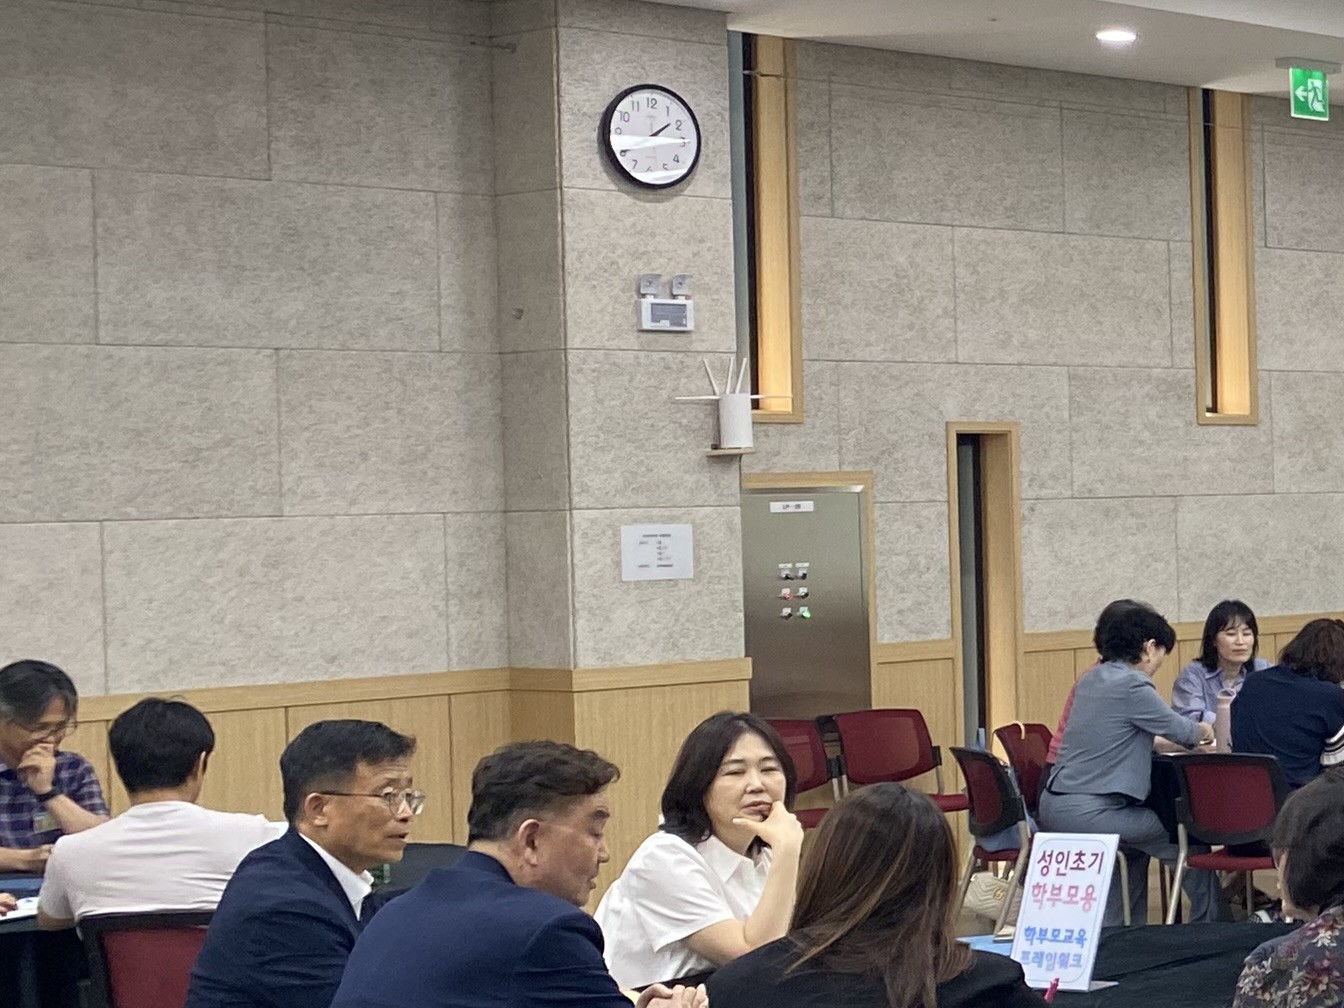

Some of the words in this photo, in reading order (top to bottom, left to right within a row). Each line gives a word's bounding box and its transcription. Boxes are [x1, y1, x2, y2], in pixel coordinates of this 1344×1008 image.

[631, 100, 640, 112] 11
[646, 97, 658, 110] 12
[619, 111, 630, 122] 10
[665, 105, 670, 117] 1
[675, 119, 682, 131] 2
[672, 154, 680, 164] 4
[1037, 849, 1105, 877] 성인초기
[1031, 881, 1098, 914] 학부모용
[1023, 925, 1088, 949] 학부모교육
[1020, 950, 1083, 973] 프레임워크
